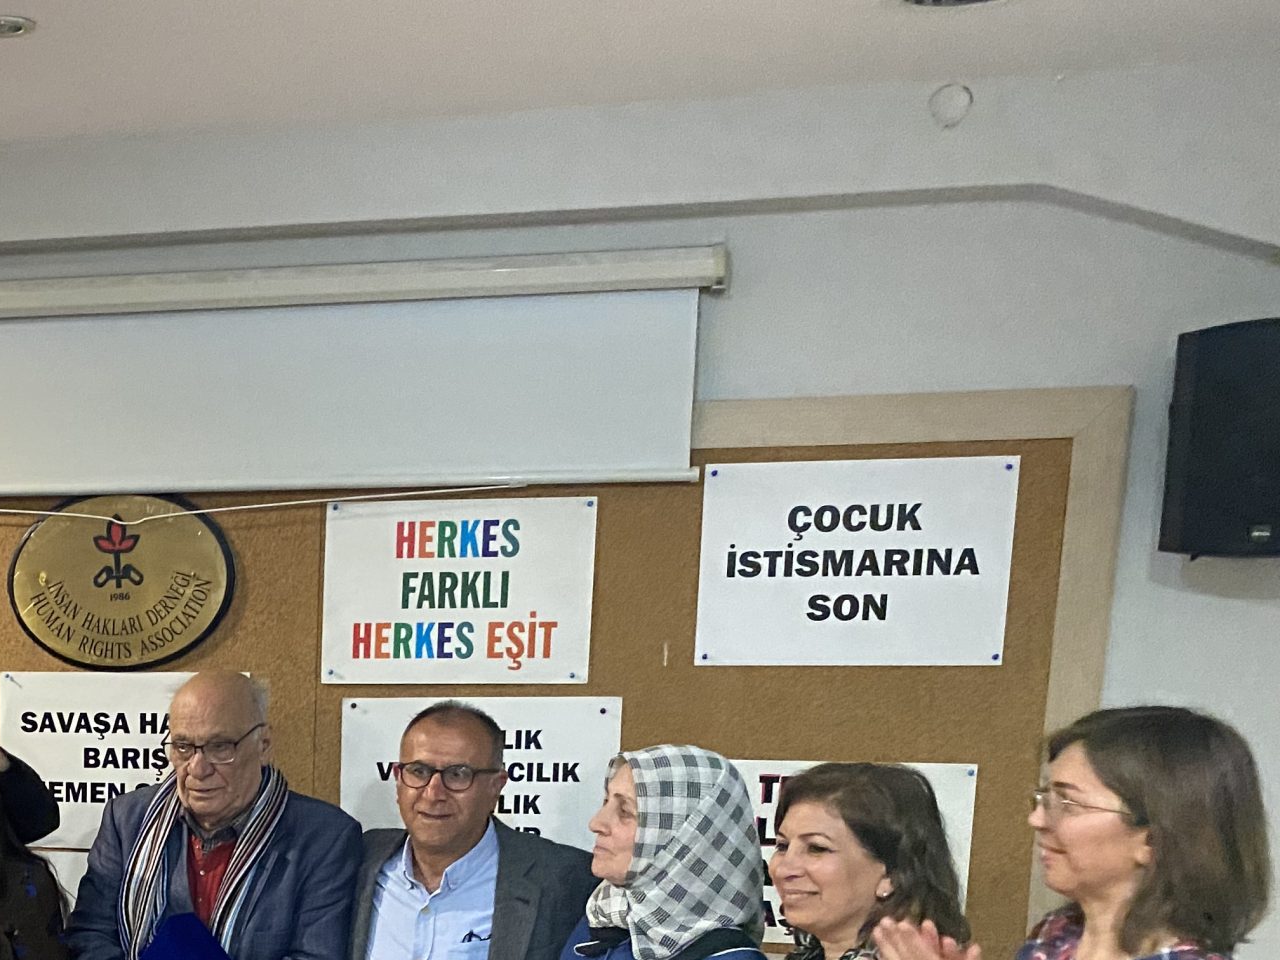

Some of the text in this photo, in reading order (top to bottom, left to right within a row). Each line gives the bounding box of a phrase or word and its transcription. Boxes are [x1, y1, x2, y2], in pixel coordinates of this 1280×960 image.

[395, 519, 521, 558] HERKES
[787, 503, 923, 541] ÇOCUK
[726, 543, 980, 577] İSTİSMARINA
[401, 571, 510, 609] FARKLI
[806, 593, 888, 621] SON
[30, 577, 213, 659] HUMAN RIGHTS ASSOCIATION
[81, 611, 144, 637] HAKLARI
[352, 611, 559, 670] HERKES EŞİT
[20, 711, 130, 740] SAVAŞA
[83, 748, 169, 777] BARIŞ
[44, 781, 126, 804] EMEN
